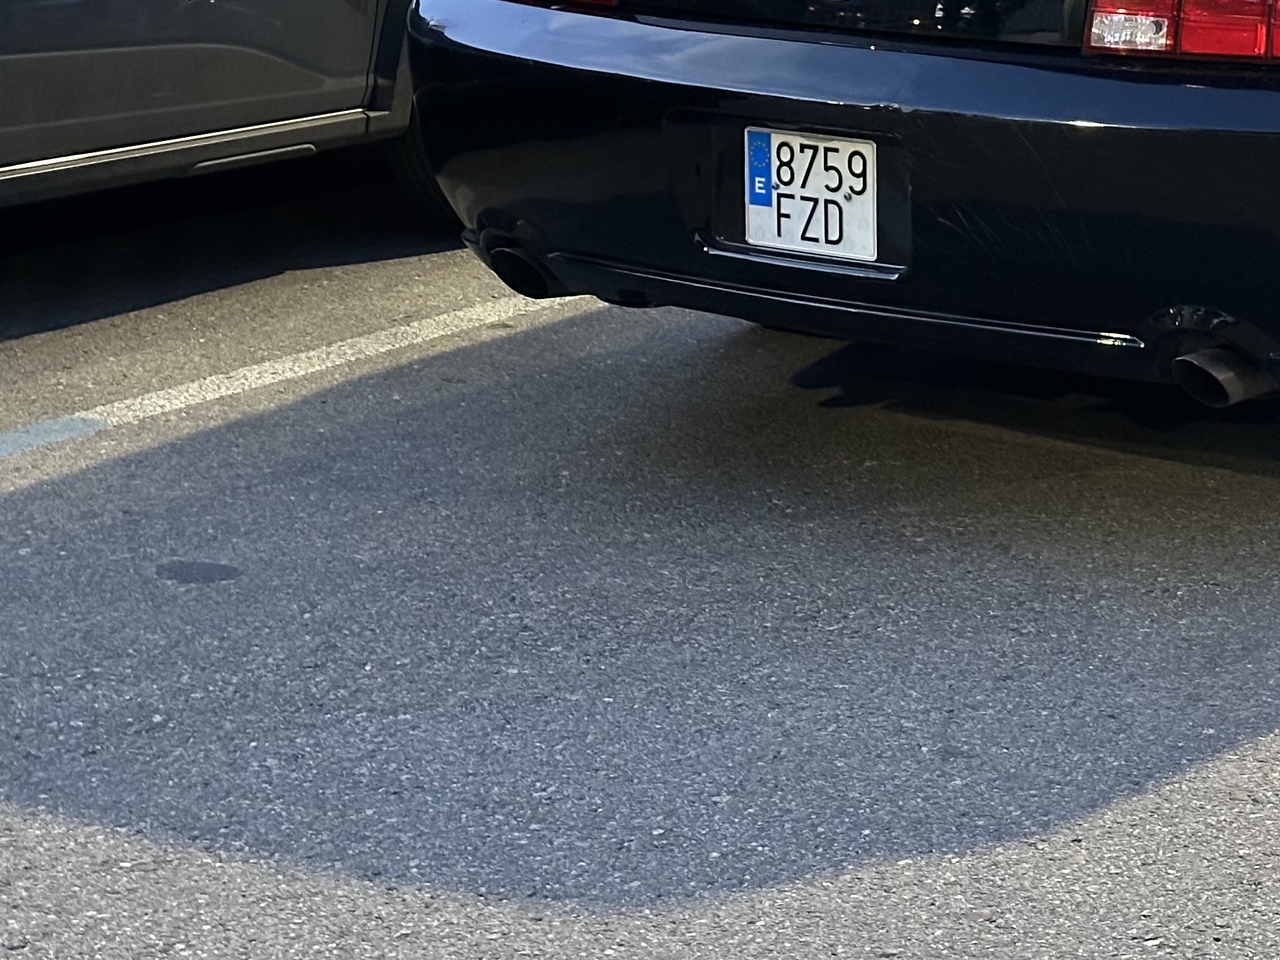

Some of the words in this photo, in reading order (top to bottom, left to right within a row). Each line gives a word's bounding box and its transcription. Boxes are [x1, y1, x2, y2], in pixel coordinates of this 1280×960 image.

[754, 176, 767, 194] E
[775, 141, 868, 196] 8759
[776, 192, 844, 246] FZD
